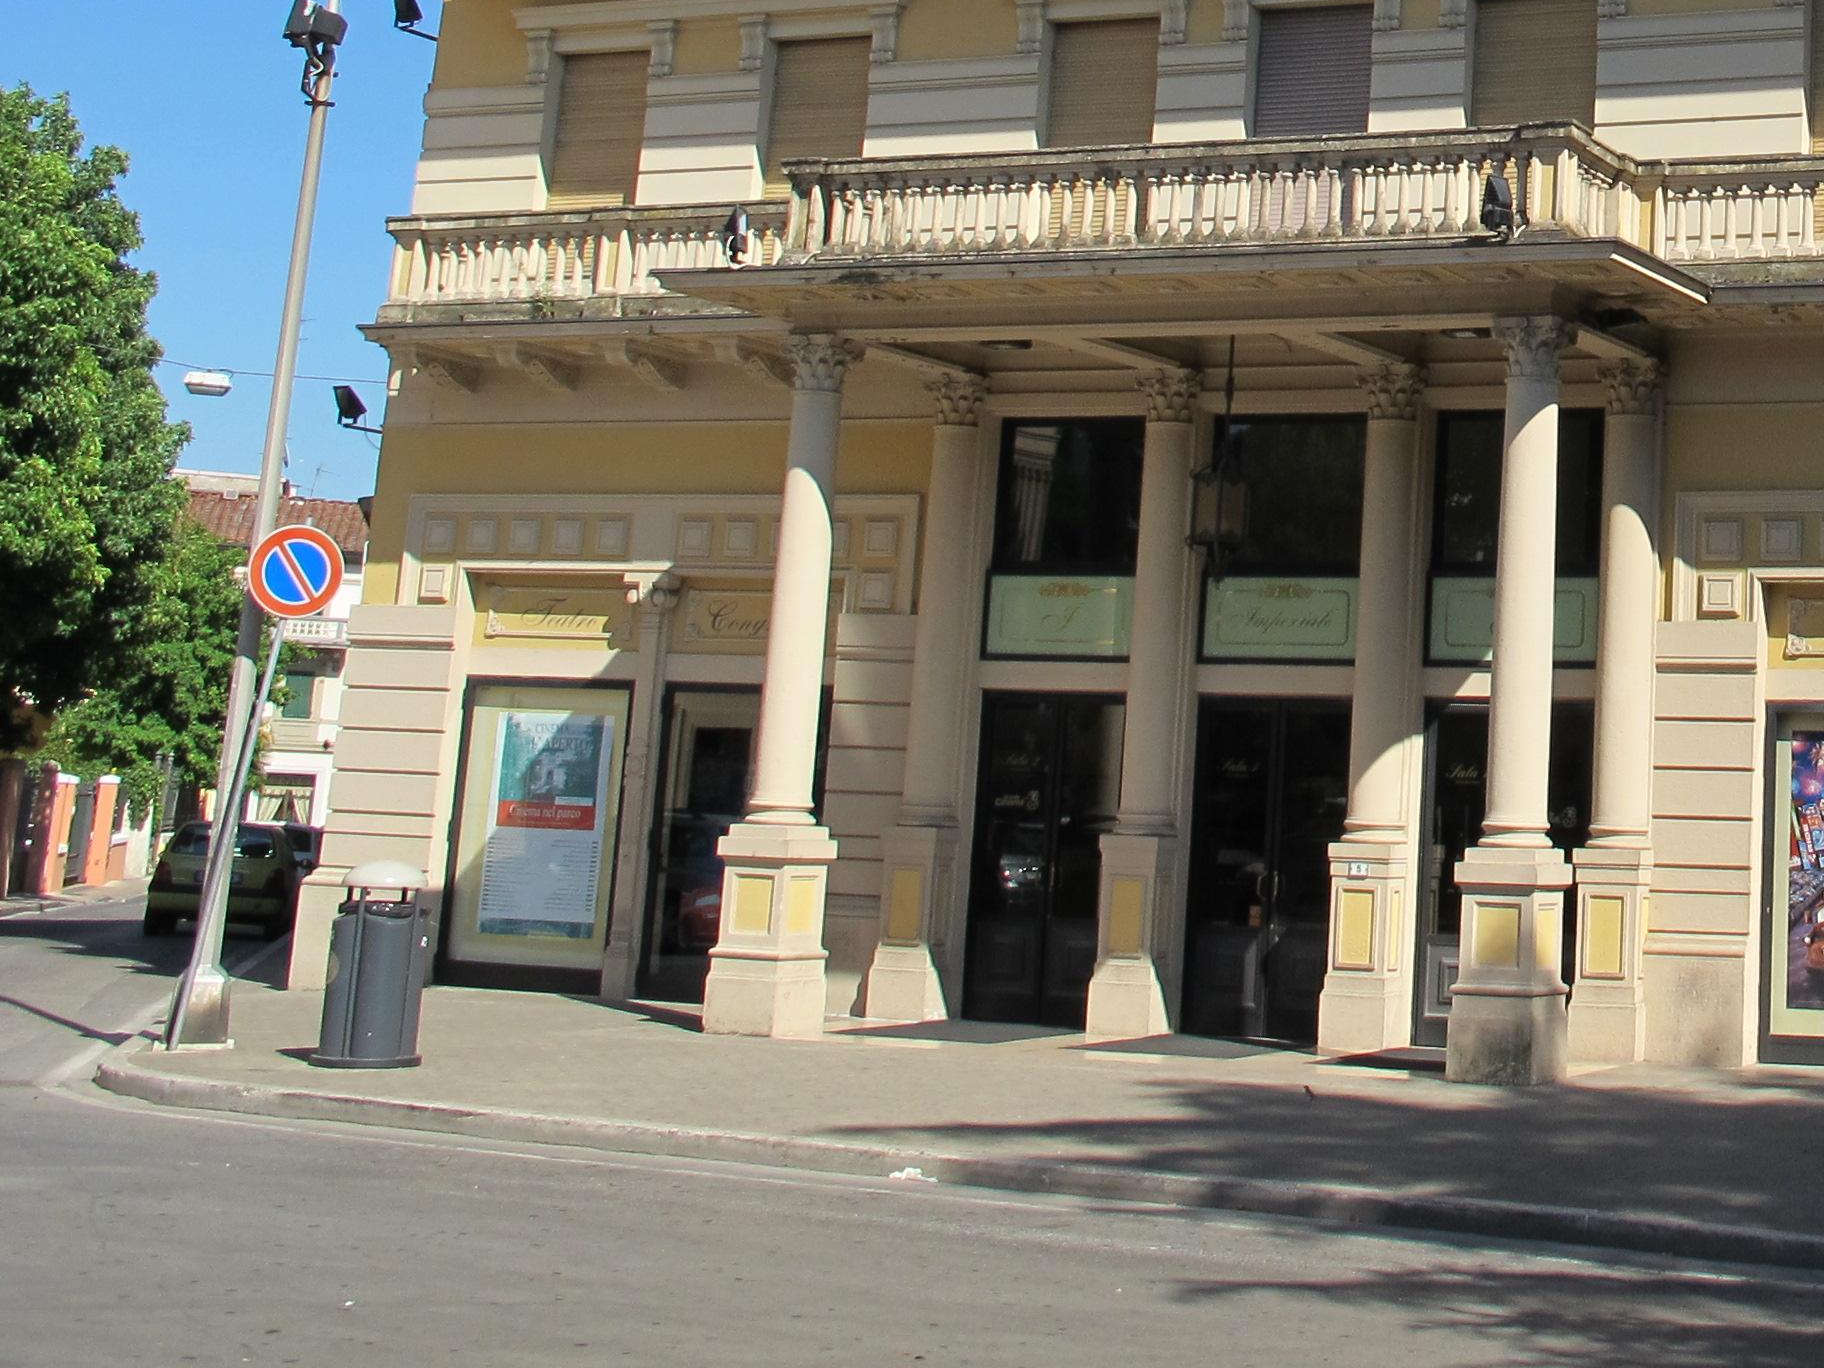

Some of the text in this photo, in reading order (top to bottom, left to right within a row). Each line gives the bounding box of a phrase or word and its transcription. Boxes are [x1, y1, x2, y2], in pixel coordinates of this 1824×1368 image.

[520, 598, 599, 629] Teatro
[707, 599, 769, 636] Cong
[1232, 605, 1336, 633] Imperiale
[509, 803, 540, 817] Cinema
